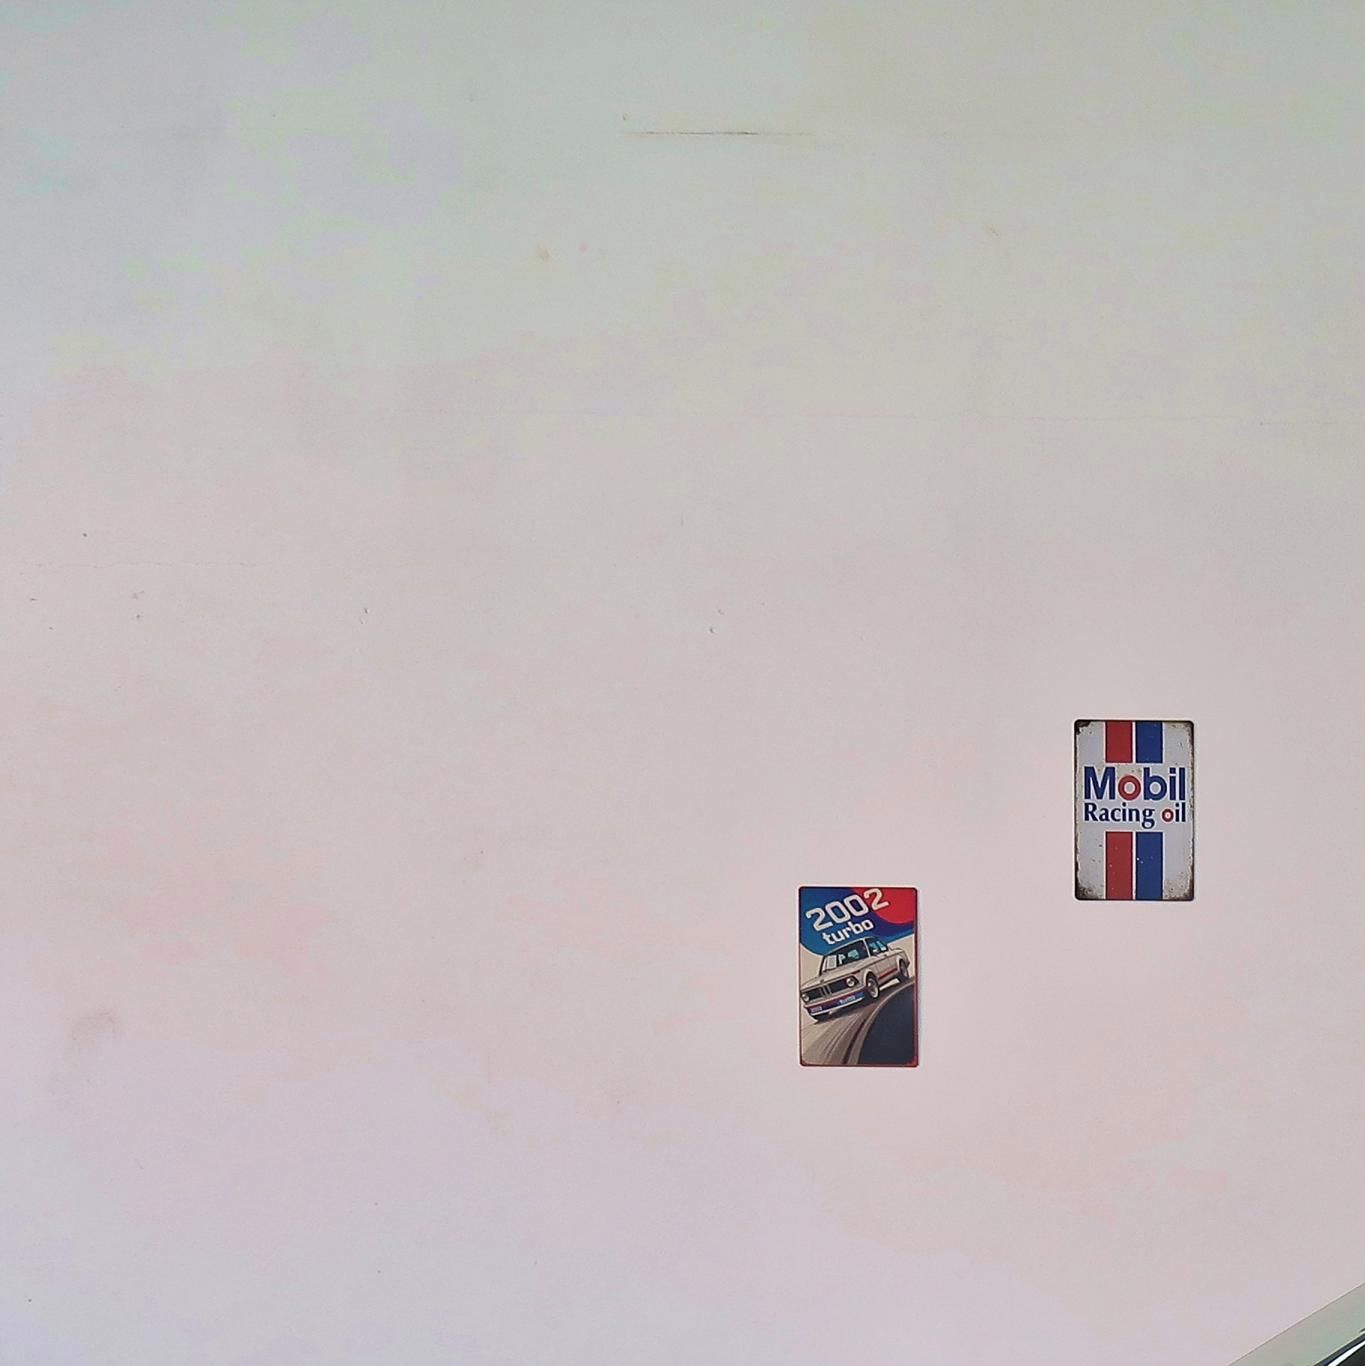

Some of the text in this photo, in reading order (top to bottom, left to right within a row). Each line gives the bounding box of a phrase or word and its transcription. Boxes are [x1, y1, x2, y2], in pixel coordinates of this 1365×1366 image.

[1083, 765, 1186, 801] Mobil
[1083, 802, 1186, 829] Racing oil
[805, 887, 890, 932] 2002
[822, 919, 874, 945] turbo
